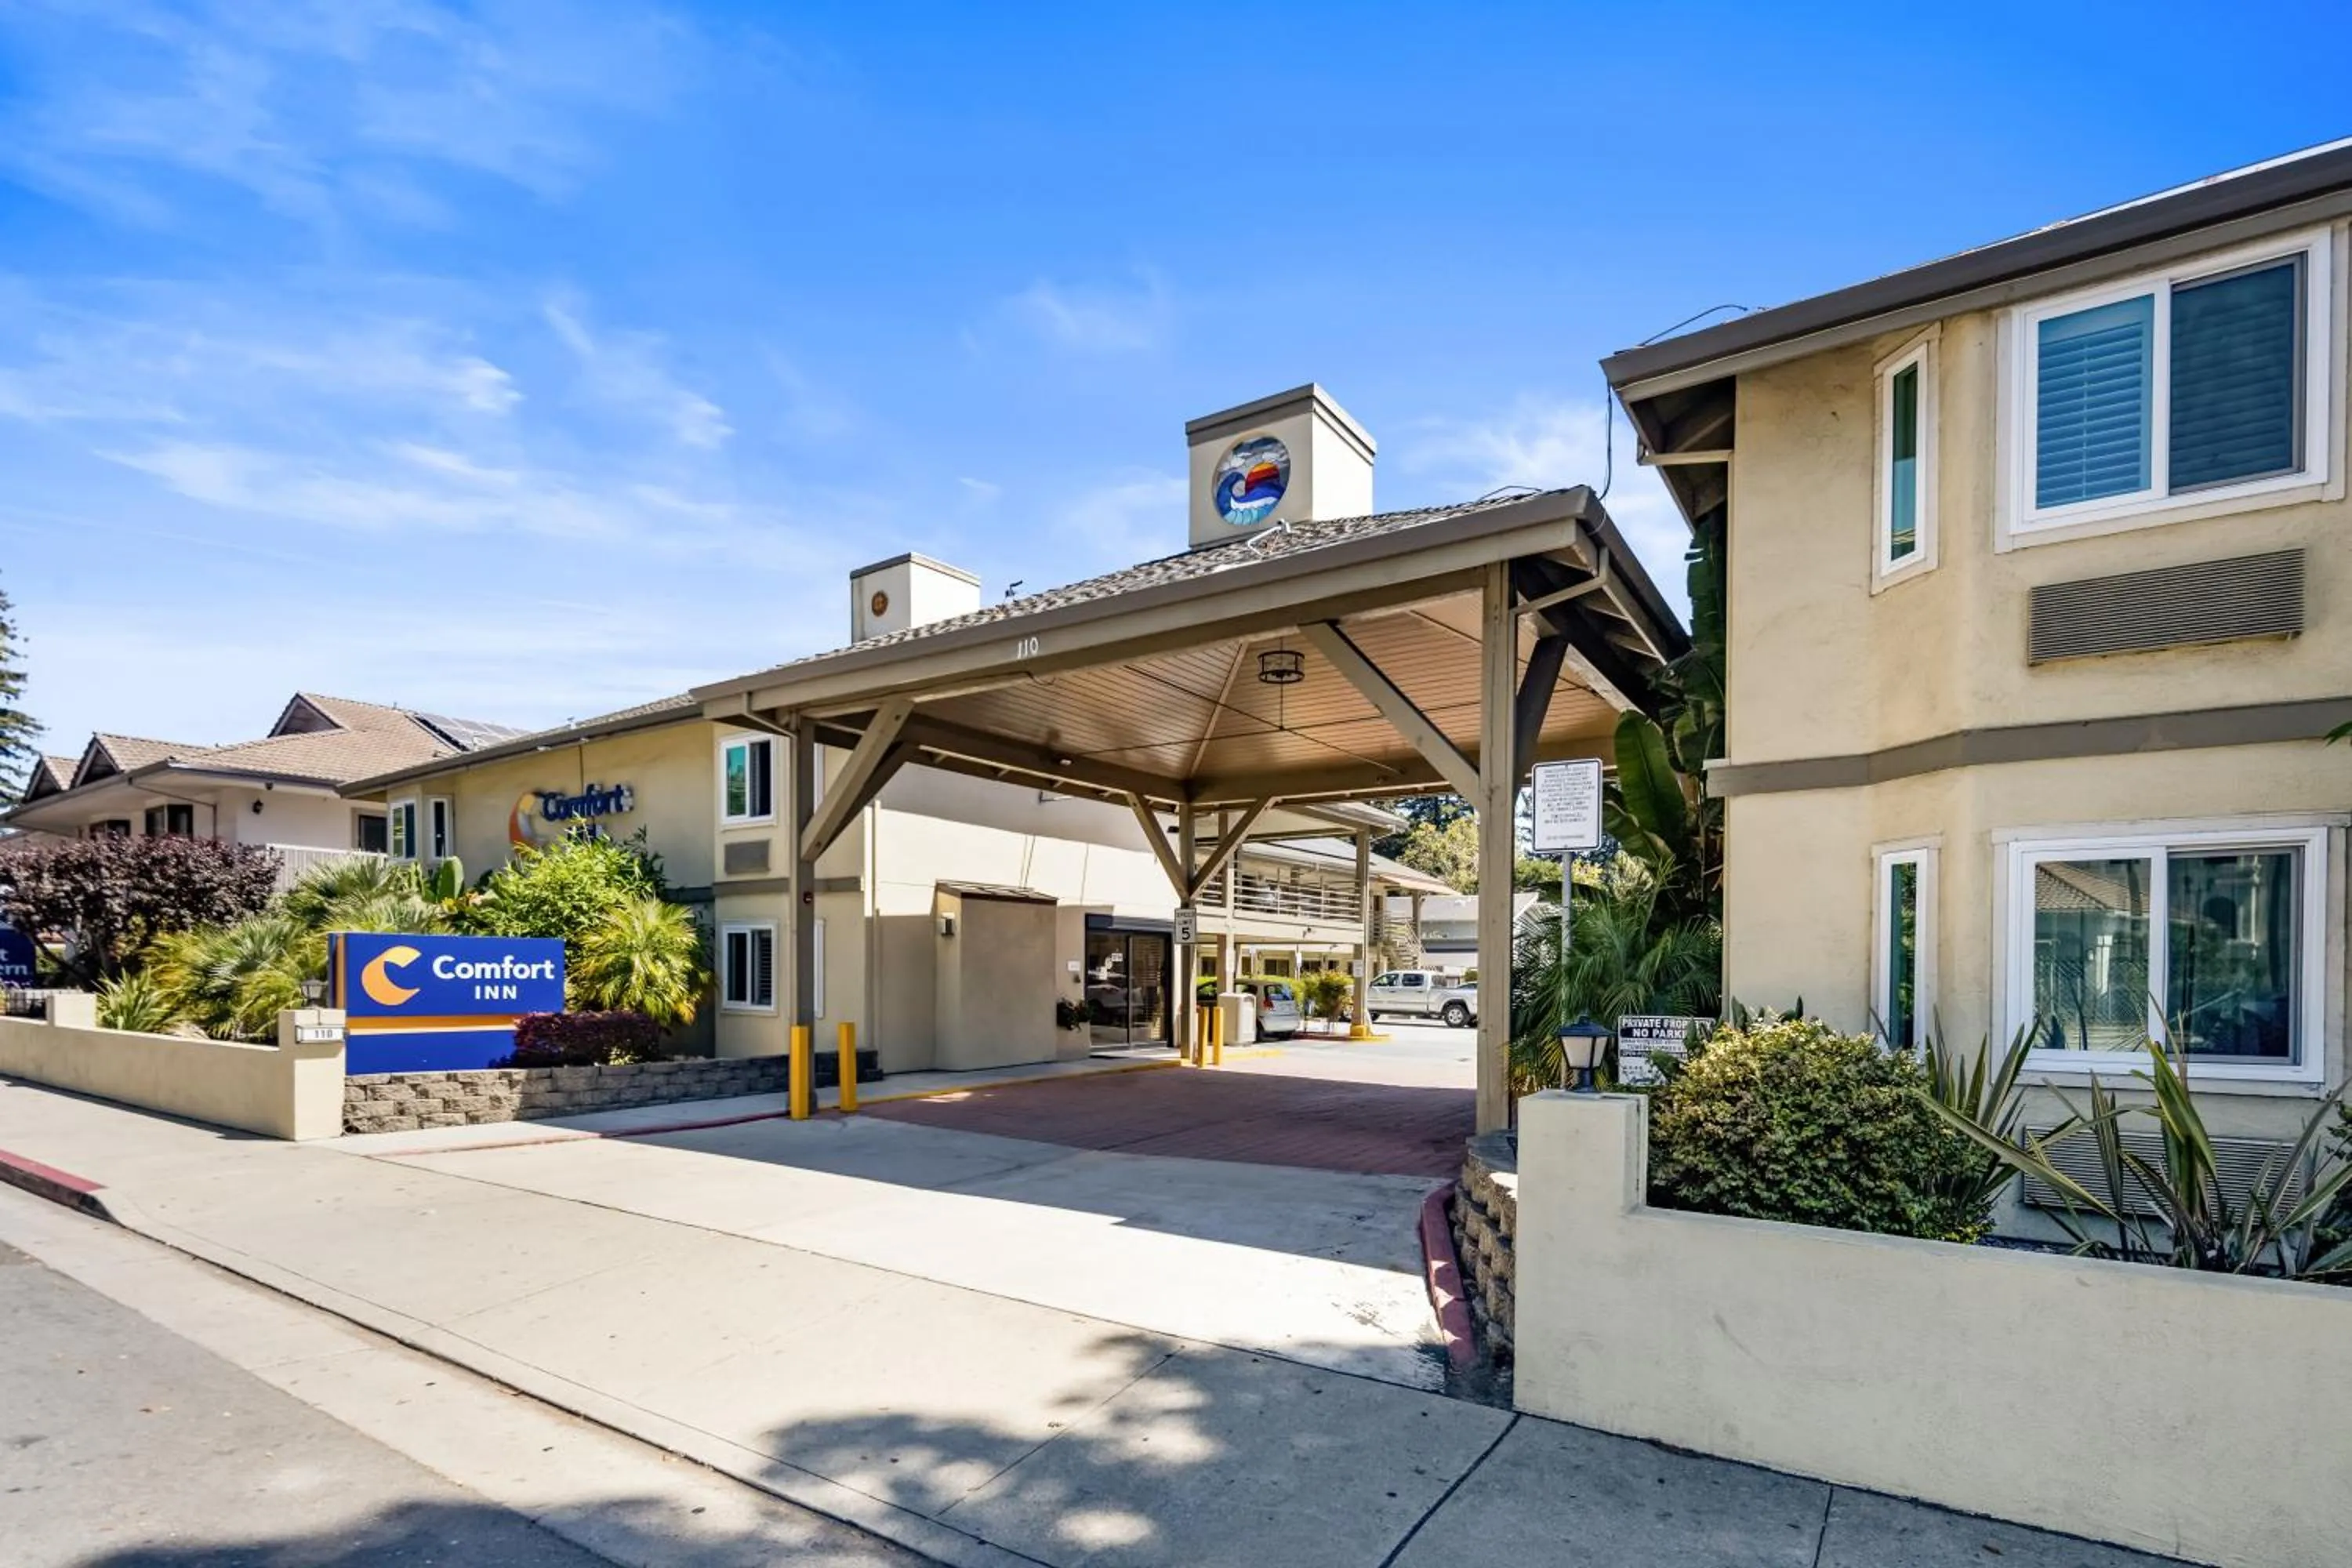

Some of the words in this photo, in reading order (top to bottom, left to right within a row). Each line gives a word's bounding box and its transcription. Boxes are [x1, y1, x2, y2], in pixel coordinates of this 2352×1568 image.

[1017, 637, 1039, 659] 110
[543, 784, 632, 821] Comfort
[1181, 927, 1191, 940] 5
[432, 955, 555, 979] Comfort
[474, 985, 517, 1000] INN
[1622, 1018, 1661, 1028] PRIVATE
[314, 1029, 333, 1038] 110
[1632, 1029, 1649, 1037] NO
[1652, 1029, 1688, 1039] PARKI
